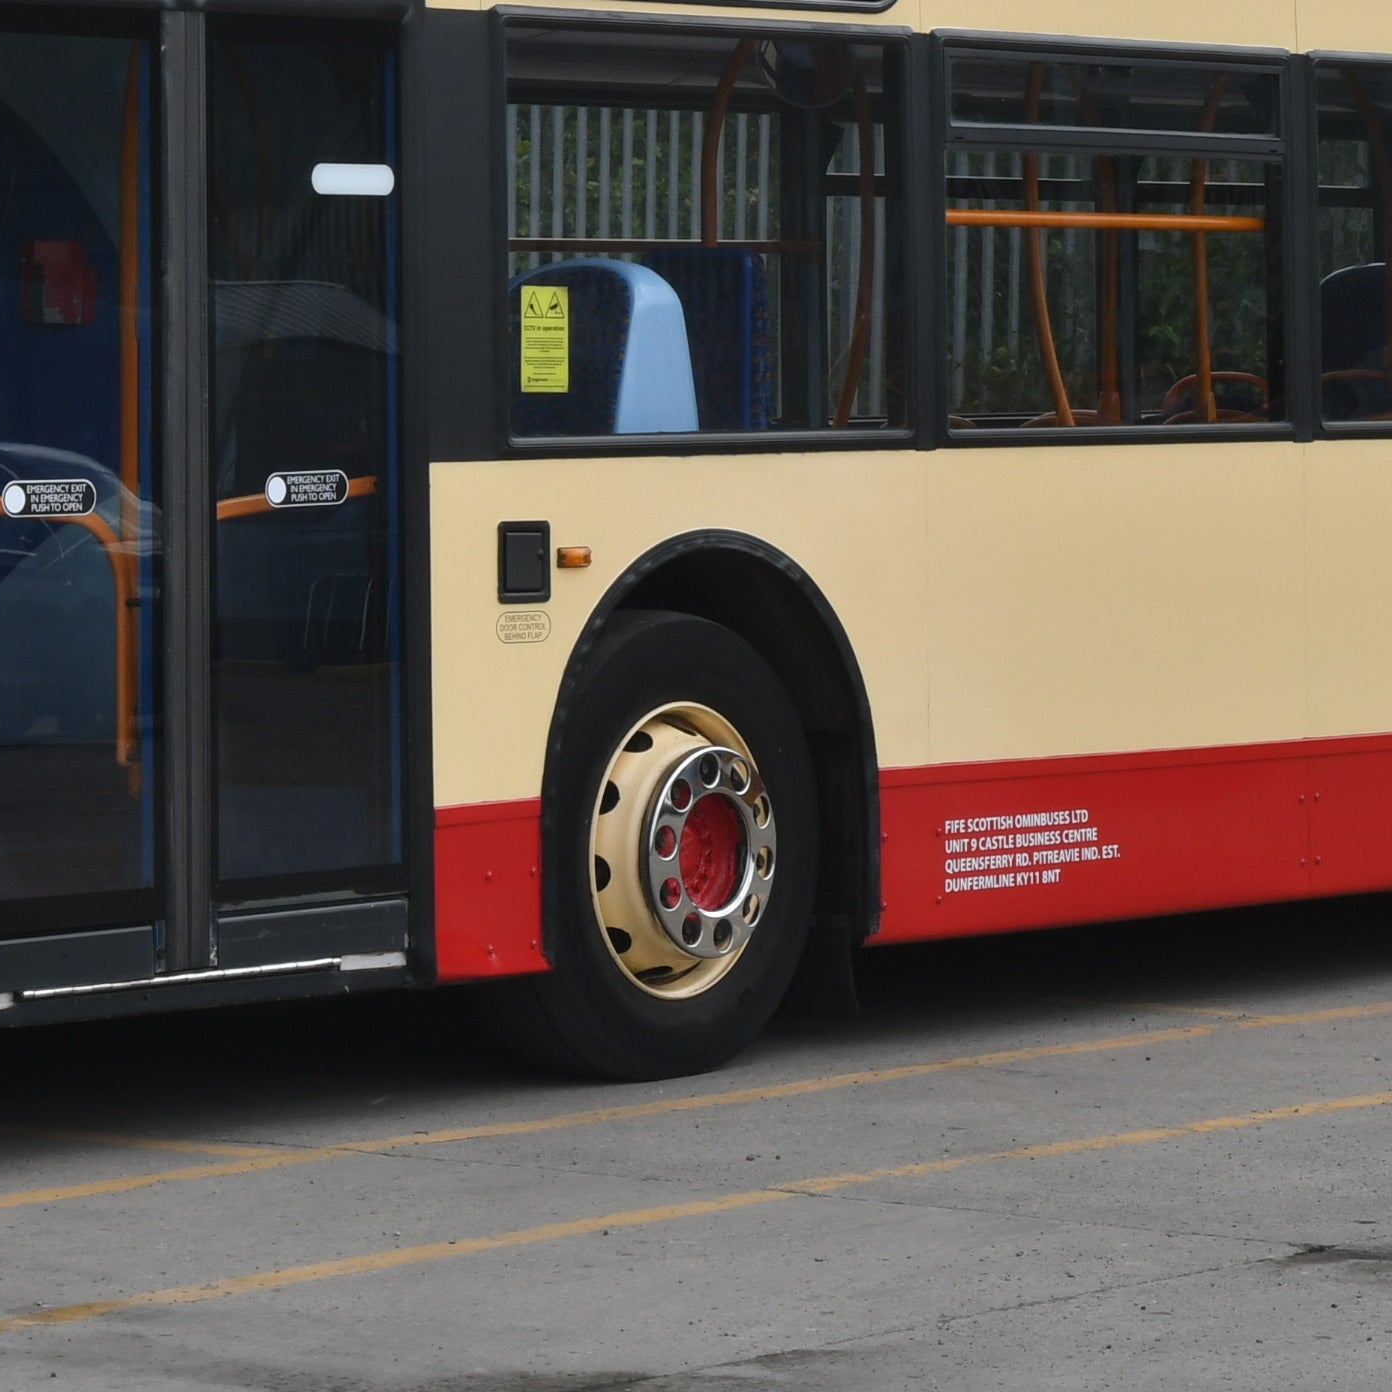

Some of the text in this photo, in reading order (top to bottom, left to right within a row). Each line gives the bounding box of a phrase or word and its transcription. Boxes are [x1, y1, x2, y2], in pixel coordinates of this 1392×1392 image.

[287, 474, 340, 484] EMERGENCY EXIT
[26, 483, 87, 494] EMERGENCY EXIT
[290, 483, 337, 493] IN EMERGENCY
[30, 493, 83, 503] IN EMERGENCY
[291, 492, 336, 502] PUSH TO OPEN
[31, 502, 82, 512] PUSH TO OPEN
[945, 809, 1088, 834] FIFE SCOTTISH OMINBUSES LTD
[945, 827, 1098, 854] UNIT 9 CASTLE BUSINESS CENTRE
[945, 844, 1121, 874] QUEENSFERRY RD. PITREAVIE IND. EST.
[945, 869, 1061, 893] DUNFERMLINE KY11 8NT
